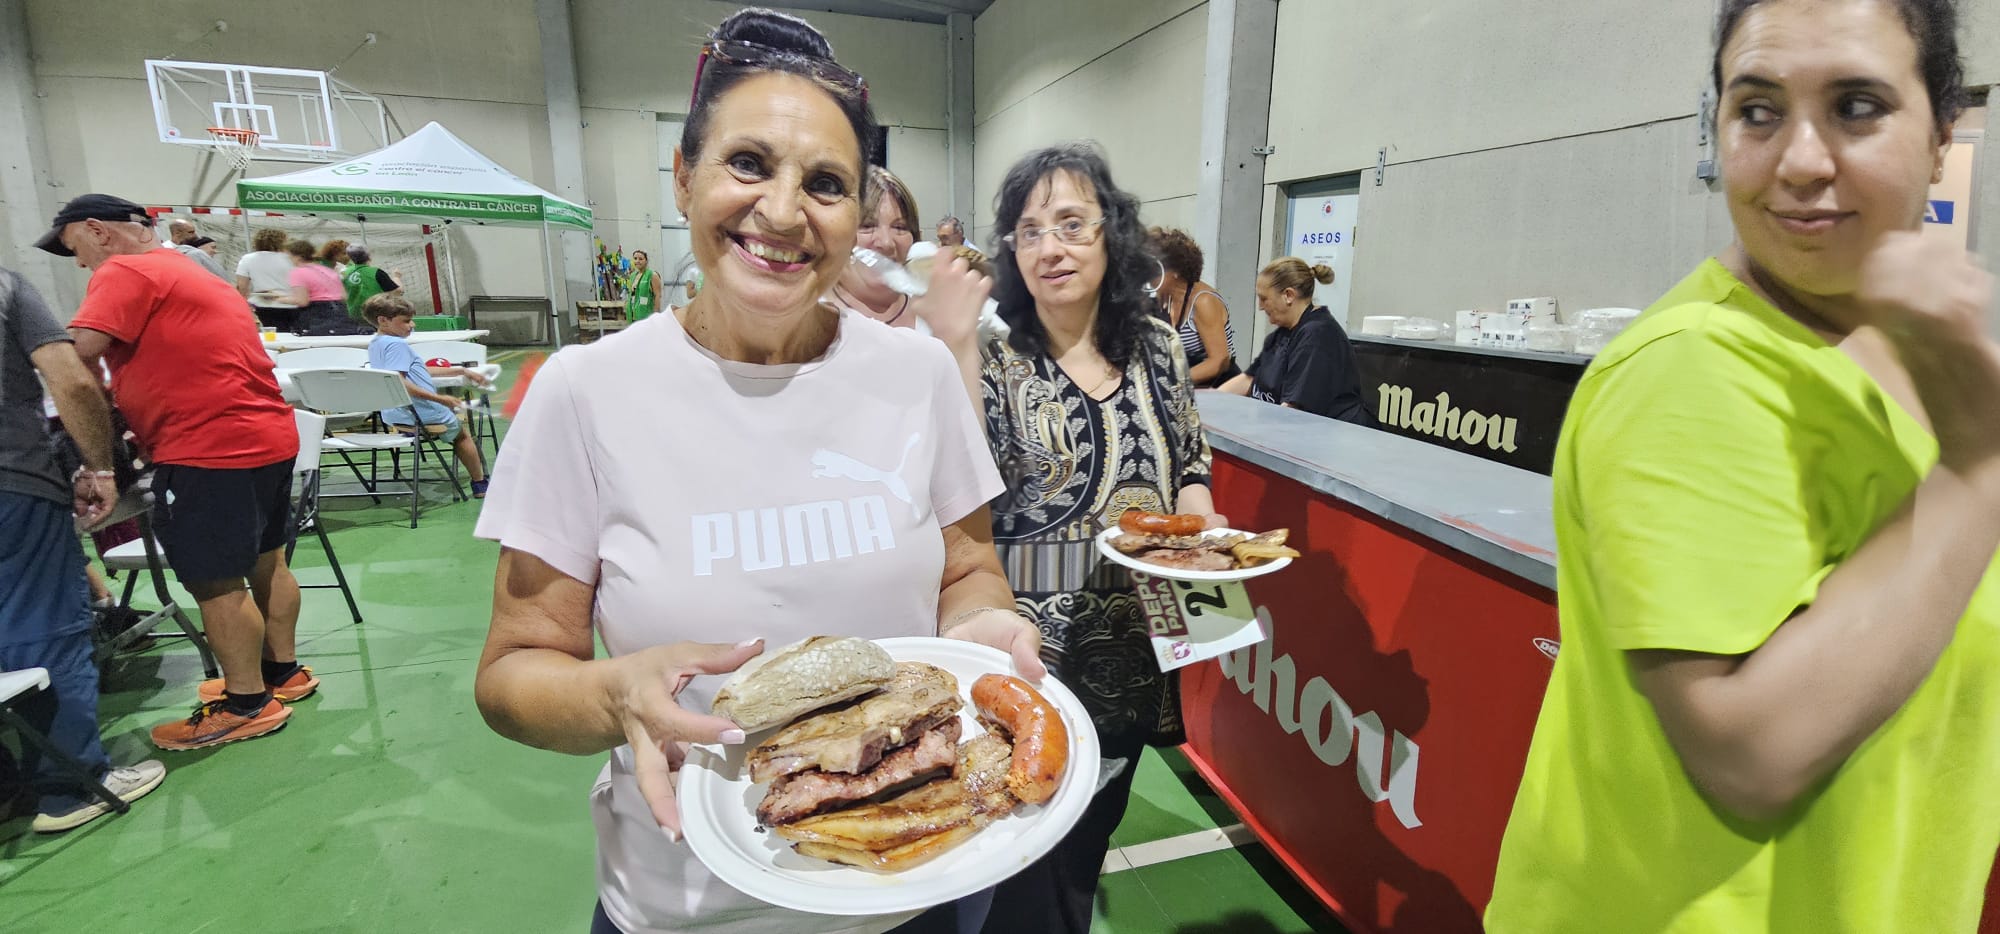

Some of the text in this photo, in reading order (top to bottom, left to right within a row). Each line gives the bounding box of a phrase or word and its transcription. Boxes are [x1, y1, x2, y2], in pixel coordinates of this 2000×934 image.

[246, 190, 538, 213] ASOCIACIÓN ESPAÑOLA CONTRA EL CÁNCER
[1302, 232, 1341, 244] ASEOS
[1378, 383, 1518, 453] Mahou
[692, 495, 896, 576] PUMA
[1130, 570, 1169, 635] DEPO
[1155, 580, 1183, 630] PARA
[1175, 580, 1228, 617] 2
[1218, 604, 1424, 830] ahou
